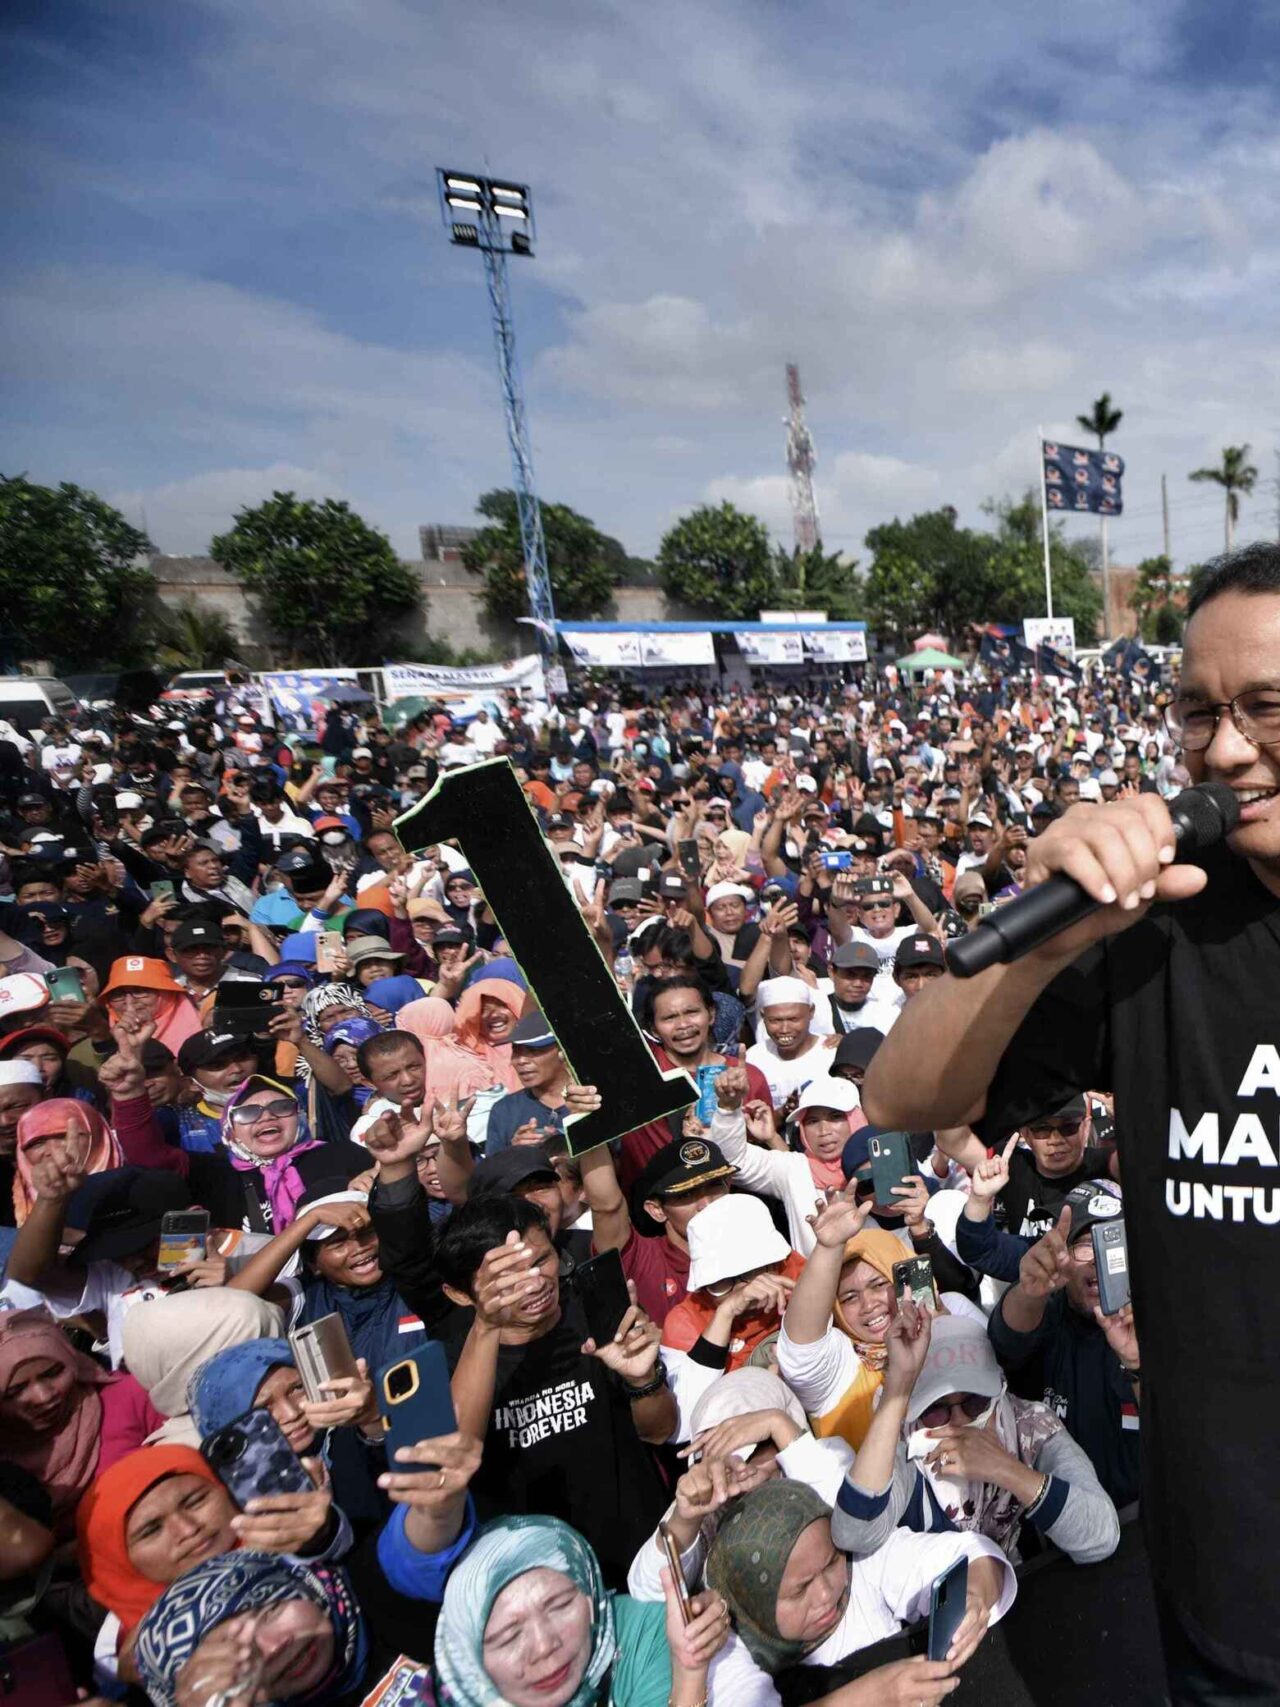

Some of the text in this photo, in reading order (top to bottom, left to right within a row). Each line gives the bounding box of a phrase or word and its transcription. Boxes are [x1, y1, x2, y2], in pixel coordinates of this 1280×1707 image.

[495, 1381, 595, 1430] INDONESIA
[555, 1380, 576, 1392] MORE
[509, 1407, 588, 1448] FOREVER
